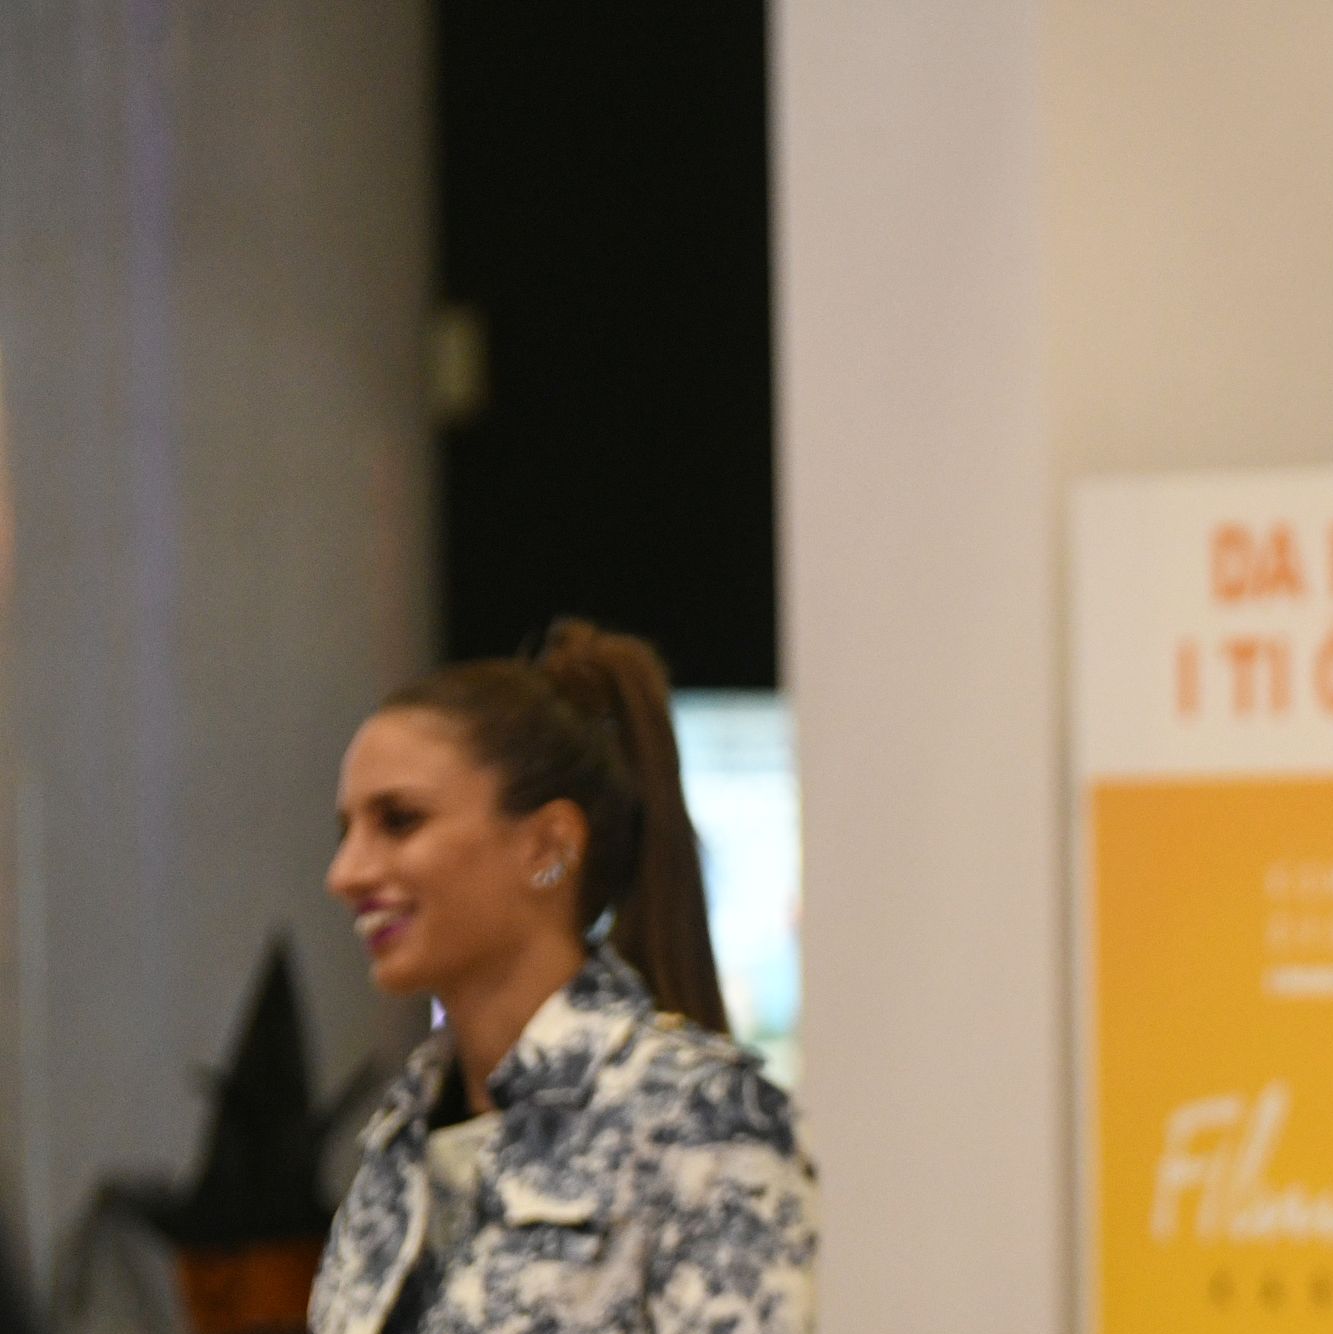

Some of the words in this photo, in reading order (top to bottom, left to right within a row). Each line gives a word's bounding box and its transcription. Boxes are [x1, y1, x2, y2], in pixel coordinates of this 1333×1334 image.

[1210, 520, 1305, 603] DA
[1175, 637, 1200, 718] I
[1221, 634, 1292, 718] TI
